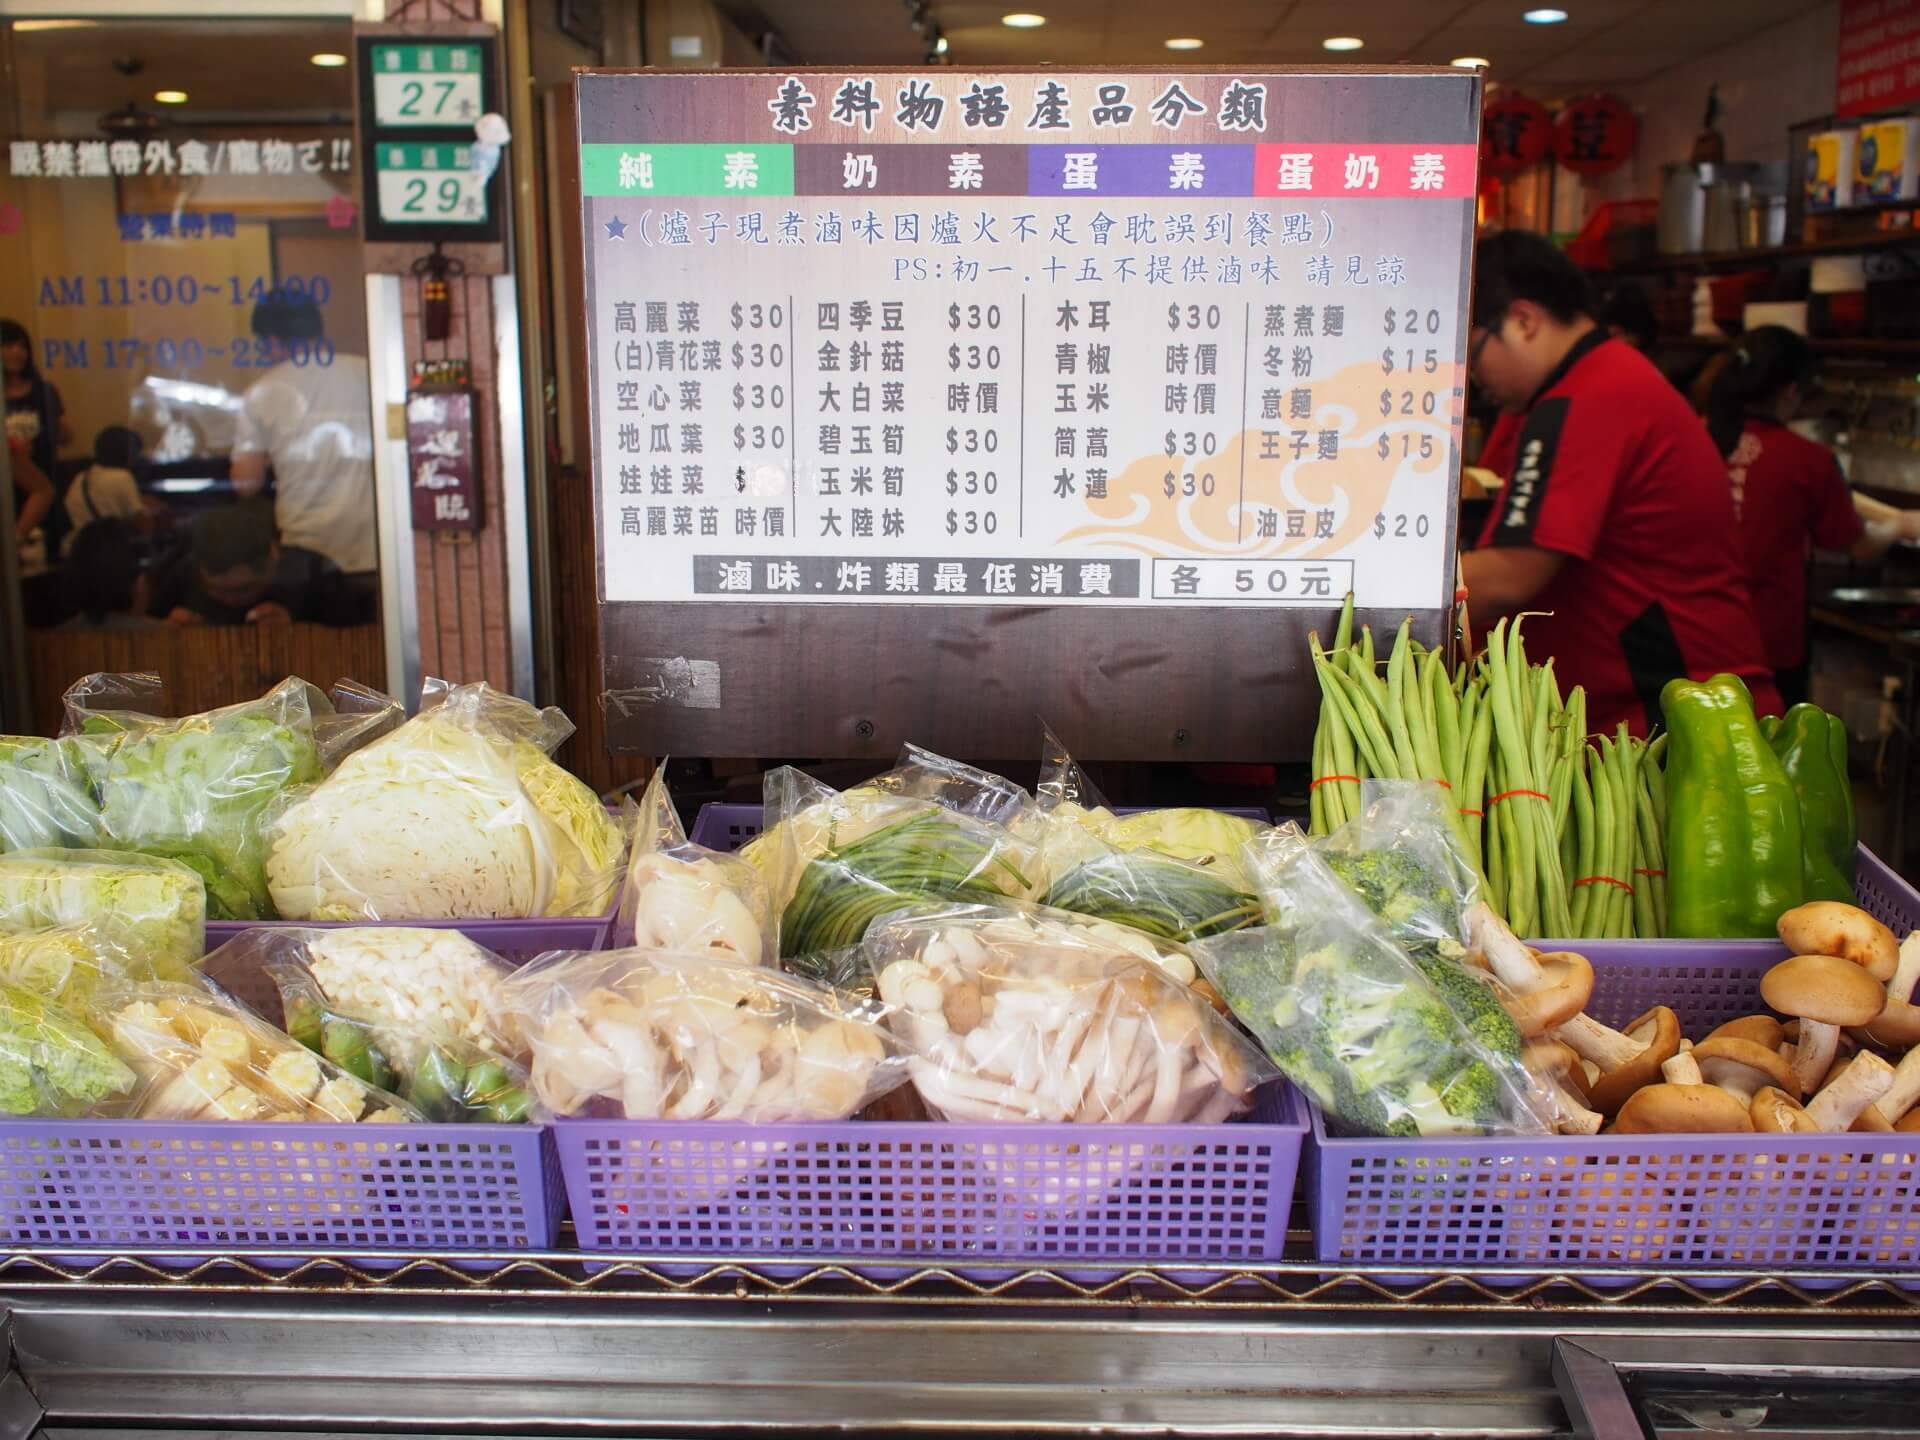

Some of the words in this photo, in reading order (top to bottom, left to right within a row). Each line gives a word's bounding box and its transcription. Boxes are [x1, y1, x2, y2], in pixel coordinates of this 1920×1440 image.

[398, 81, 458, 117] 27
[770, 78, 1268, 134] 素料物語產品分類
[402, 178, 462, 213] 29
[640, 210, 1334, 250] (爐子現煮滷味因爐火不足會耽誤到餐點)
[1306, 257, 1407, 288] 請見諒
[39, 276, 85, 305] AM
[613, 300, 700, 334] 高麗菜
[730, 301, 783, 331] $30
[818, 300, 905, 333] 四季豆
[948, 301, 1001, 332] $30
[1055, 299, 1111, 332] 木耳
[1167, 301, 1221, 332] $30
[1383, 306, 1440, 337] $20
[43, 338, 89, 370] PM
[731, 340, 783, 370] $30
[817, 339, 905, 372] 金針菇
[948, 342, 1001, 373] $30
[1055, 342, 1111, 375] 青椒
[1166, 343, 1217, 376] 時價
[1263, 344, 1313, 378] 冬粉
[1381, 346, 1438, 377] $15
[617, 380, 702, 412] 空心菜
[732, 382, 784, 411] $30
[818, 381, 905, 413] 大白菜
[947, 381, 998, 414] 時價
[1054, 382, 1110, 413] 玉米
[1165, 382, 1217, 415] 時價
[1379, 388, 1436, 417] $20
[618, 422, 703, 455] 地瓜葉
[733, 423, 785, 452] $30
[818, 423, 905, 456] 碧玉筍
[946, 426, 998, 456] $30
[1164, 429, 1217, 459] $30
[1377, 431, 1433, 461] $15
[619, 464, 704, 496] 娃娃菜
[819, 465, 905, 497] 玉米筍
[945, 468, 997, 497] $30
[1053, 467, 1108, 500] 水蓮
[1163, 470, 1215, 500] $30
[620, 505, 719, 537] 高麗菜苗
[735, 506, 785, 537] 時價
[820, 507, 905, 538] 大陸妹
[946, 508, 997, 537] $30
[1256, 508, 1335, 539] 油豆皮
[1373, 511, 1429, 540] $20
